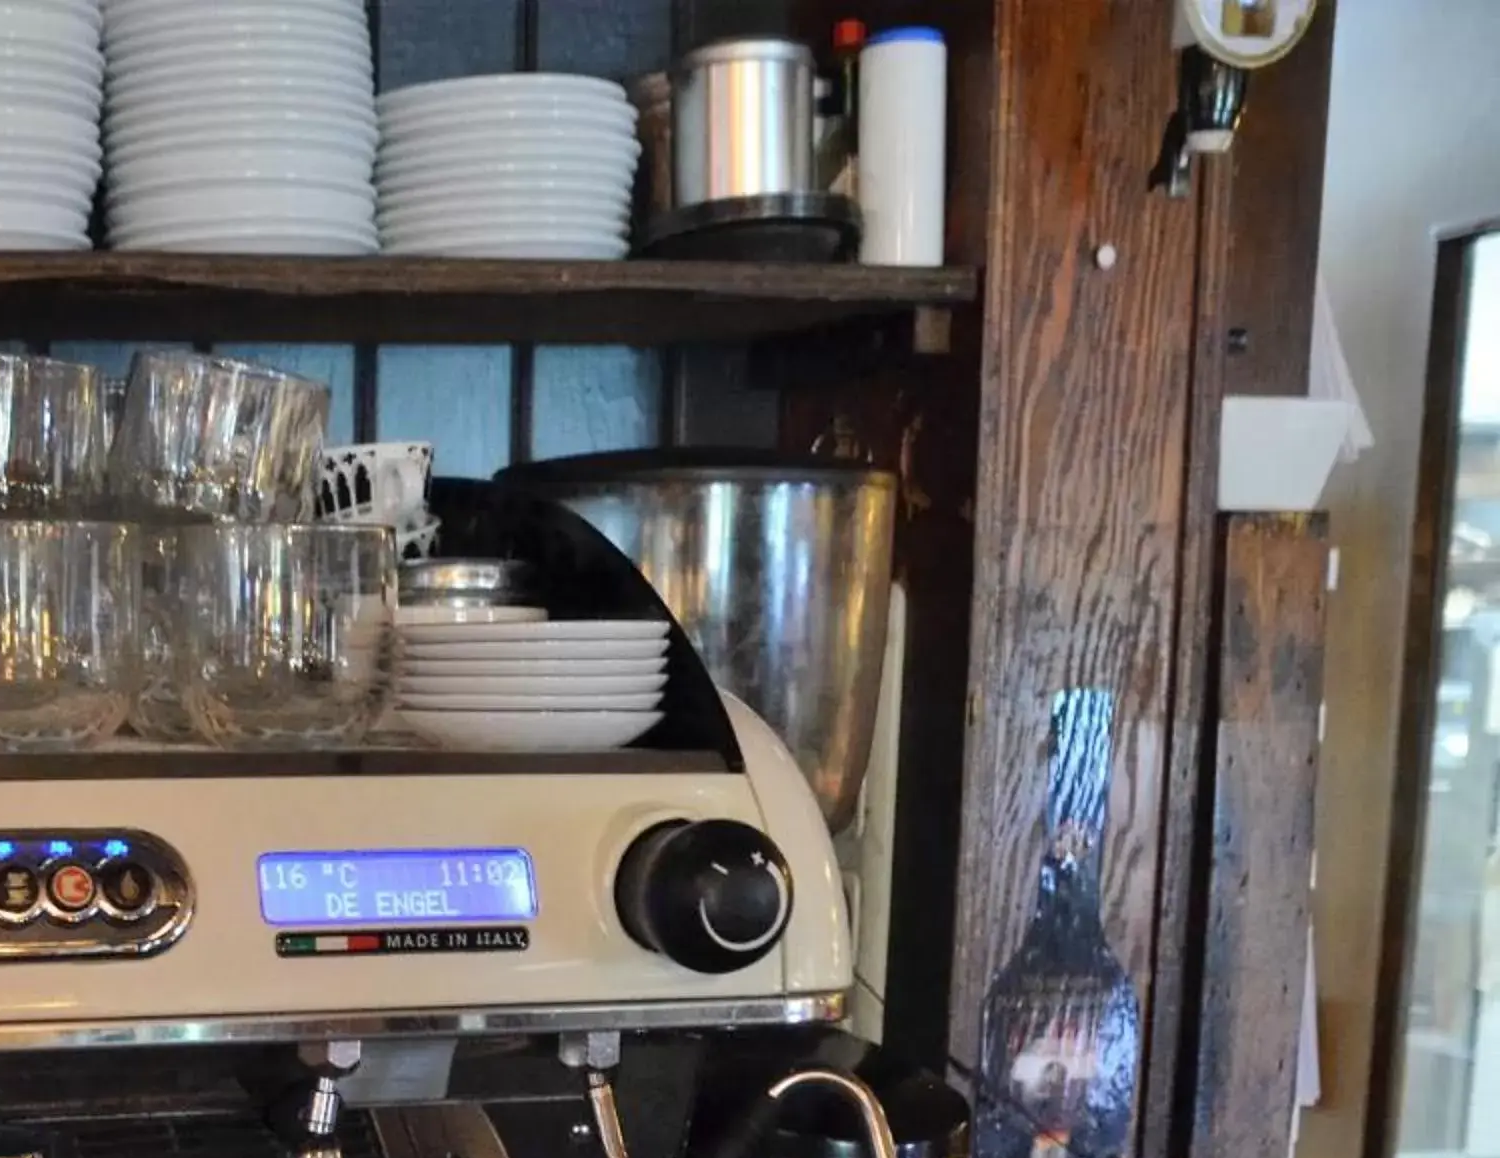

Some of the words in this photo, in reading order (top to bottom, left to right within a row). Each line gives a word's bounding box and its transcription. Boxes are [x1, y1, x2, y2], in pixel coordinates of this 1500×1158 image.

[325, 892, 360, 917] DE
[376, 890, 461, 916] ENGEL
[386, 933, 440, 950] MADE
[448, 932, 469, 947] IN
[475, 930, 525, 946] ITALY
